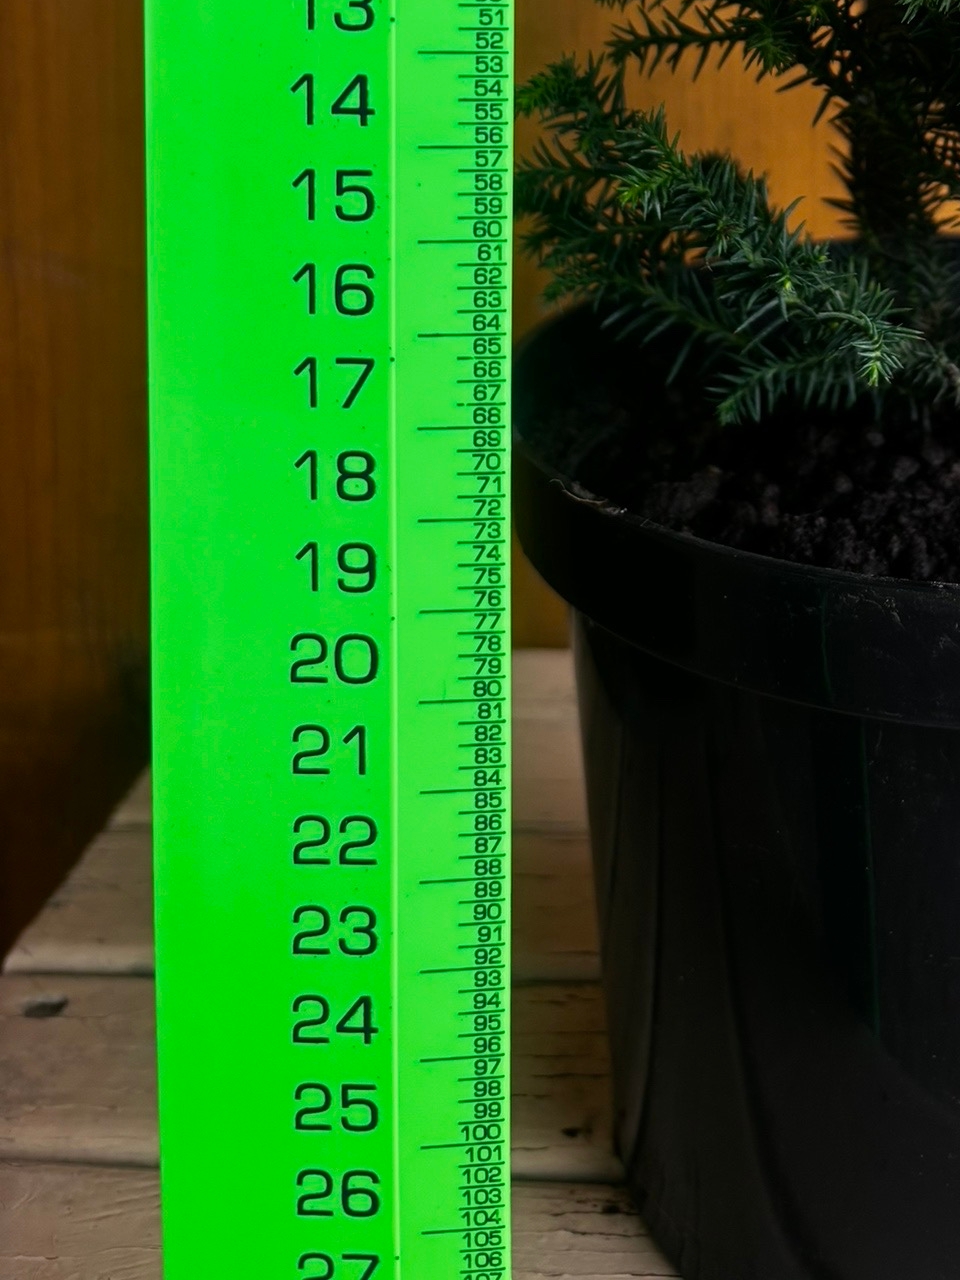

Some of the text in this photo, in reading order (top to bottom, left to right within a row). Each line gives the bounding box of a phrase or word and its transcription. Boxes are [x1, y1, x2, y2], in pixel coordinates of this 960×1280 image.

[479, 9, 504, 25] 51
[475, 33, 504, 49] 52
[475, 56, 504, 73] 53
[474, 80, 503, 96] 54
[291, 74, 375, 126] 14
[474, 104, 503, 120] 55
[474, 127, 503, 143] 56
[475, 151, 503, 167] 57
[474, 174, 503, 190] 58
[292, 169, 375, 222] 15
[474, 198, 503, 214] 59
[472, 221, 503, 237] 60
[477, 244, 502, 261] 61
[473, 268, 502, 284] 62
[293, 263, 374, 316] 16
[473, 291, 502, 307] 63
[472, 314, 501, 331] 64
[472, 338, 502, 354] 65
[473, 361, 502, 377] 66
[294, 357, 374, 409] 17
[473, 384, 501, 400] 67
[472, 407, 501, 423] 68
[472, 430, 501, 446] 69
[474, 453, 501, 469] 70
[294, 450, 376, 502] 18
[480, 476, 502, 492] 71
[474, 499, 501, 515] 72
[474, 522, 501, 538] 73
[474, 545, 502, 561] 74
[296, 542, 376, 593] 19
[474, 568, 502, 584] 75
[474, 590, 502, 607] 76
[474, 613, 501, 629] 77
[474, 636, 502, 652] 78
[290, 633, 379, 684] 20
[474, 658, 502, 675] 79
[472, 681, 502, 697] 80
[477, 703, 502, 720] 81
[474, 726, 502, 742] 82
[292, 724, 366, 775] 21
[474, 748, 502, 765] 83
[473, 771, 502, 787] 84
[474, 793, 502, 810] 85
[474, 815, 502, 832] 86
[293, 815, 377, 865] 22
[474, 838, 501, 854] 87
[474, 860, 502, 876] 88
[474, 882, 502, 899] 89
[473, 904, 502, 921] 90
[293, 905, 378, 957] 23
[477, 926, 502, 943] 91
[474, 948, 502, 965] 92
[473, 970, 502, 987] 93
[473, 992, 502, 1009] 94
[293, 995, 378, 1044] 24
[473, 1014, 502, 1031] 95
[473, 1036, 502, 1053] 96
[474, 1058, 502, 1075] 97
[473, 1080, 502, 1097] 98
[295, 1083, 378, 1132] 25
[473, 1101, 502, 1118] 99
[460, 1123, 502, 1140] 100
[465, 1145, 502, 1162] 101
[462, 1166, 502, 1183] 102
[297, 1169, 380, 1217] 26
[462, 1188, 502, 1205] 103
[461, 1209, 502, 1226] 104
[462, 1231, 502, 1248] 105
[463, 1252, 503, 1269] 106
